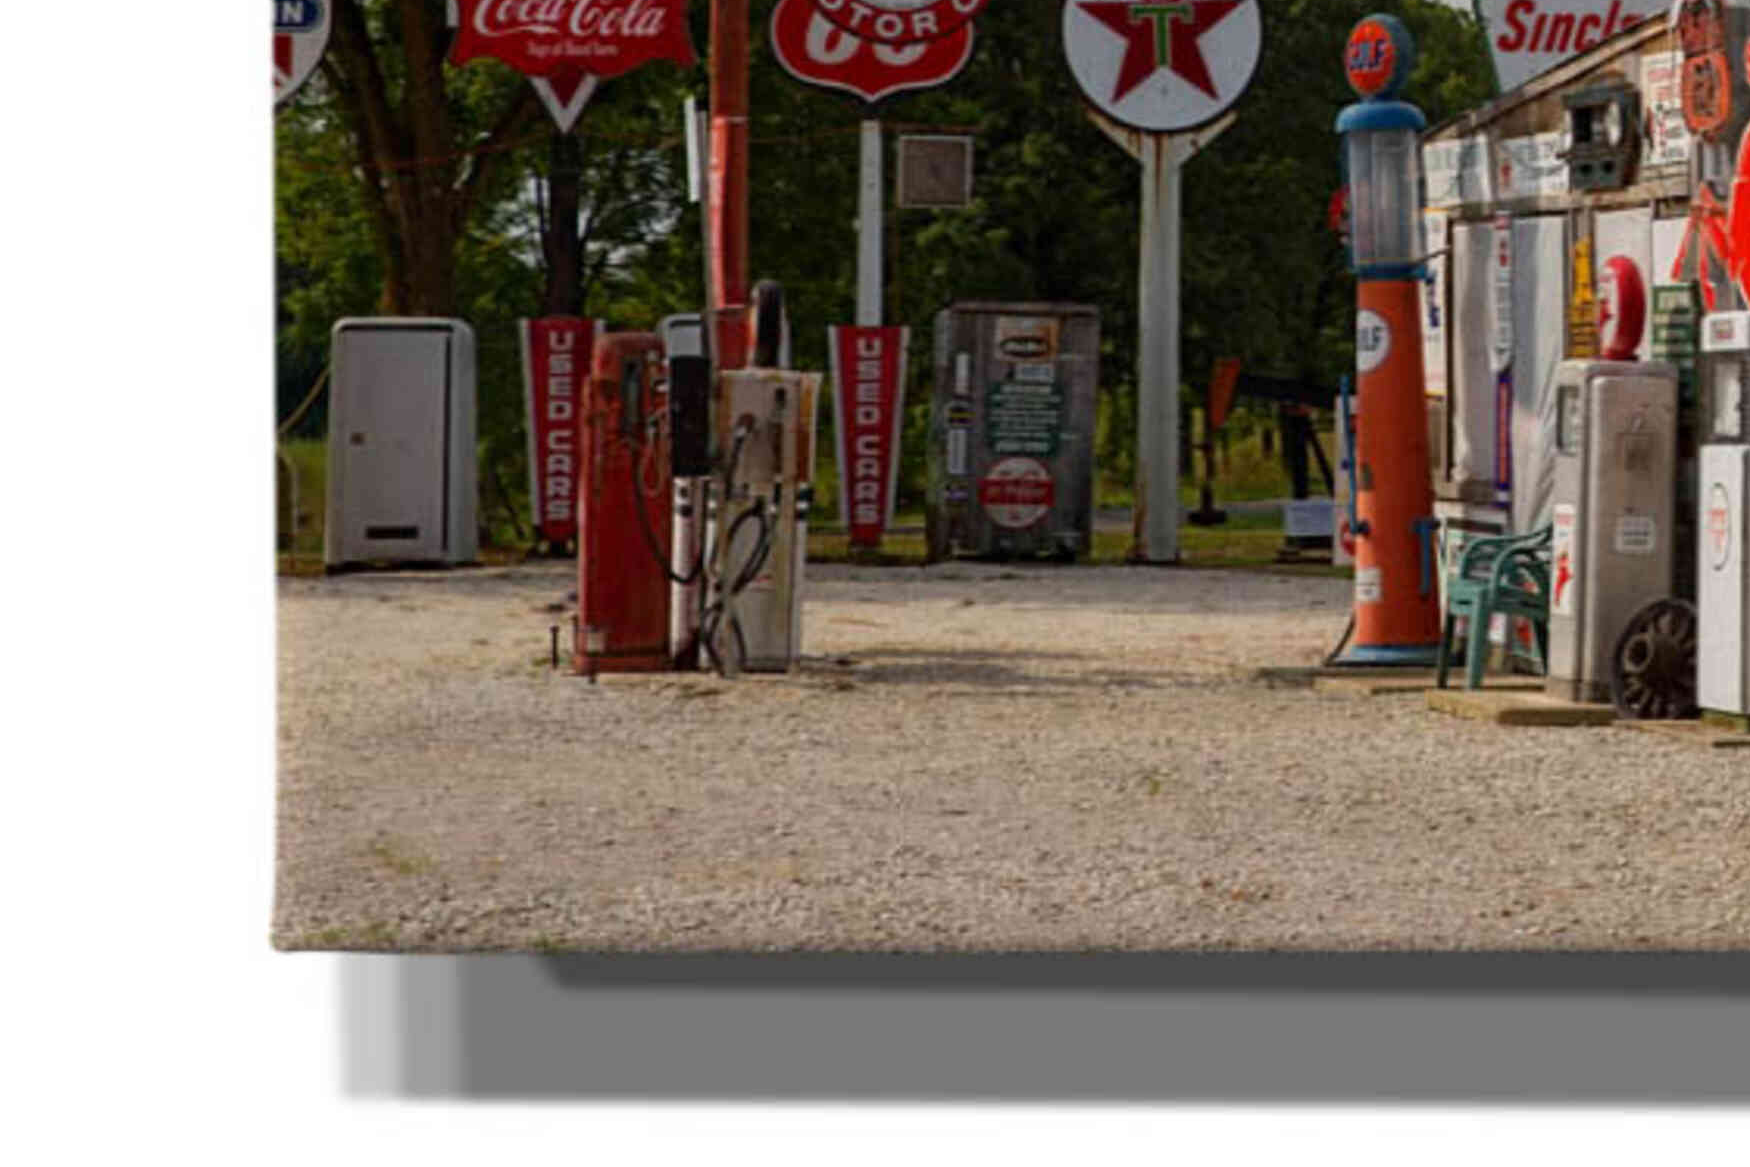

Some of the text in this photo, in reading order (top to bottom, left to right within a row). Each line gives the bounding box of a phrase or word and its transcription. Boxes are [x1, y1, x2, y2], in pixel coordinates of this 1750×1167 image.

[547, 330, 574, 521] USED CARS
[855, 336, 883, 524] USED CARS
